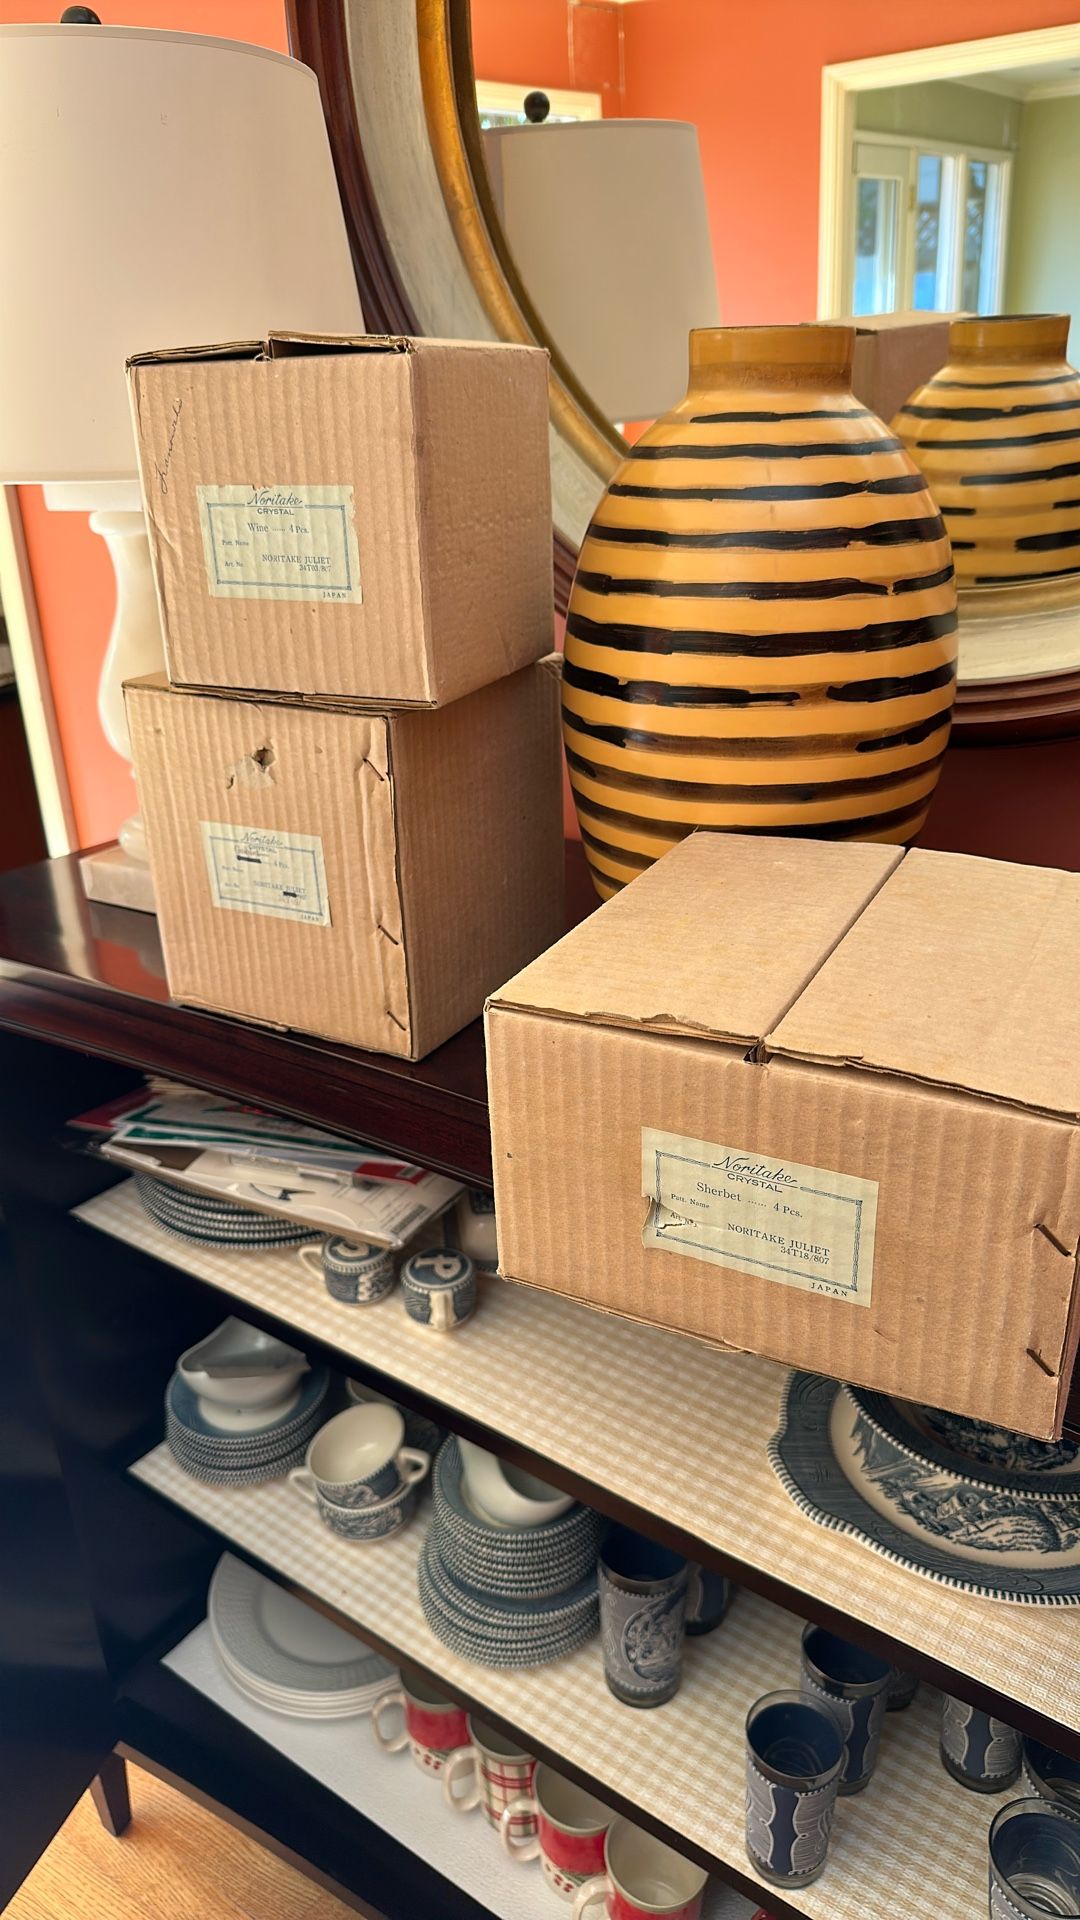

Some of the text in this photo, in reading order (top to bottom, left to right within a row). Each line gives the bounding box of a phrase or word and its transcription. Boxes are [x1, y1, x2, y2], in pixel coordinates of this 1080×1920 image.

[247, 491, 303, 506] Noritake
[257, 508, 295, 516] CRYSTAL
[247, 522, 310, 534] Wine 4 Pcs.
[262, 554, 331, 565] NORITAKE JULIET
[713, 1156, 799, 1183] Noritake
[727, 1173, 783, 1193] CRYSTAL
[690, 1198, 710, 1209] Name
[697, 1182, 742, 1202] Sherbet
[773, 1203, 779, 1212] 4
[783, 1205, 803, 1218] Pcs.
[728, 1223, 830, 1257] NORITAKE JULIET
[780, 1246, 830, 1265] 34T18/807
[414, 1255, 461, 1279] P
[811, 1282, 849, 1297] JAPAN
